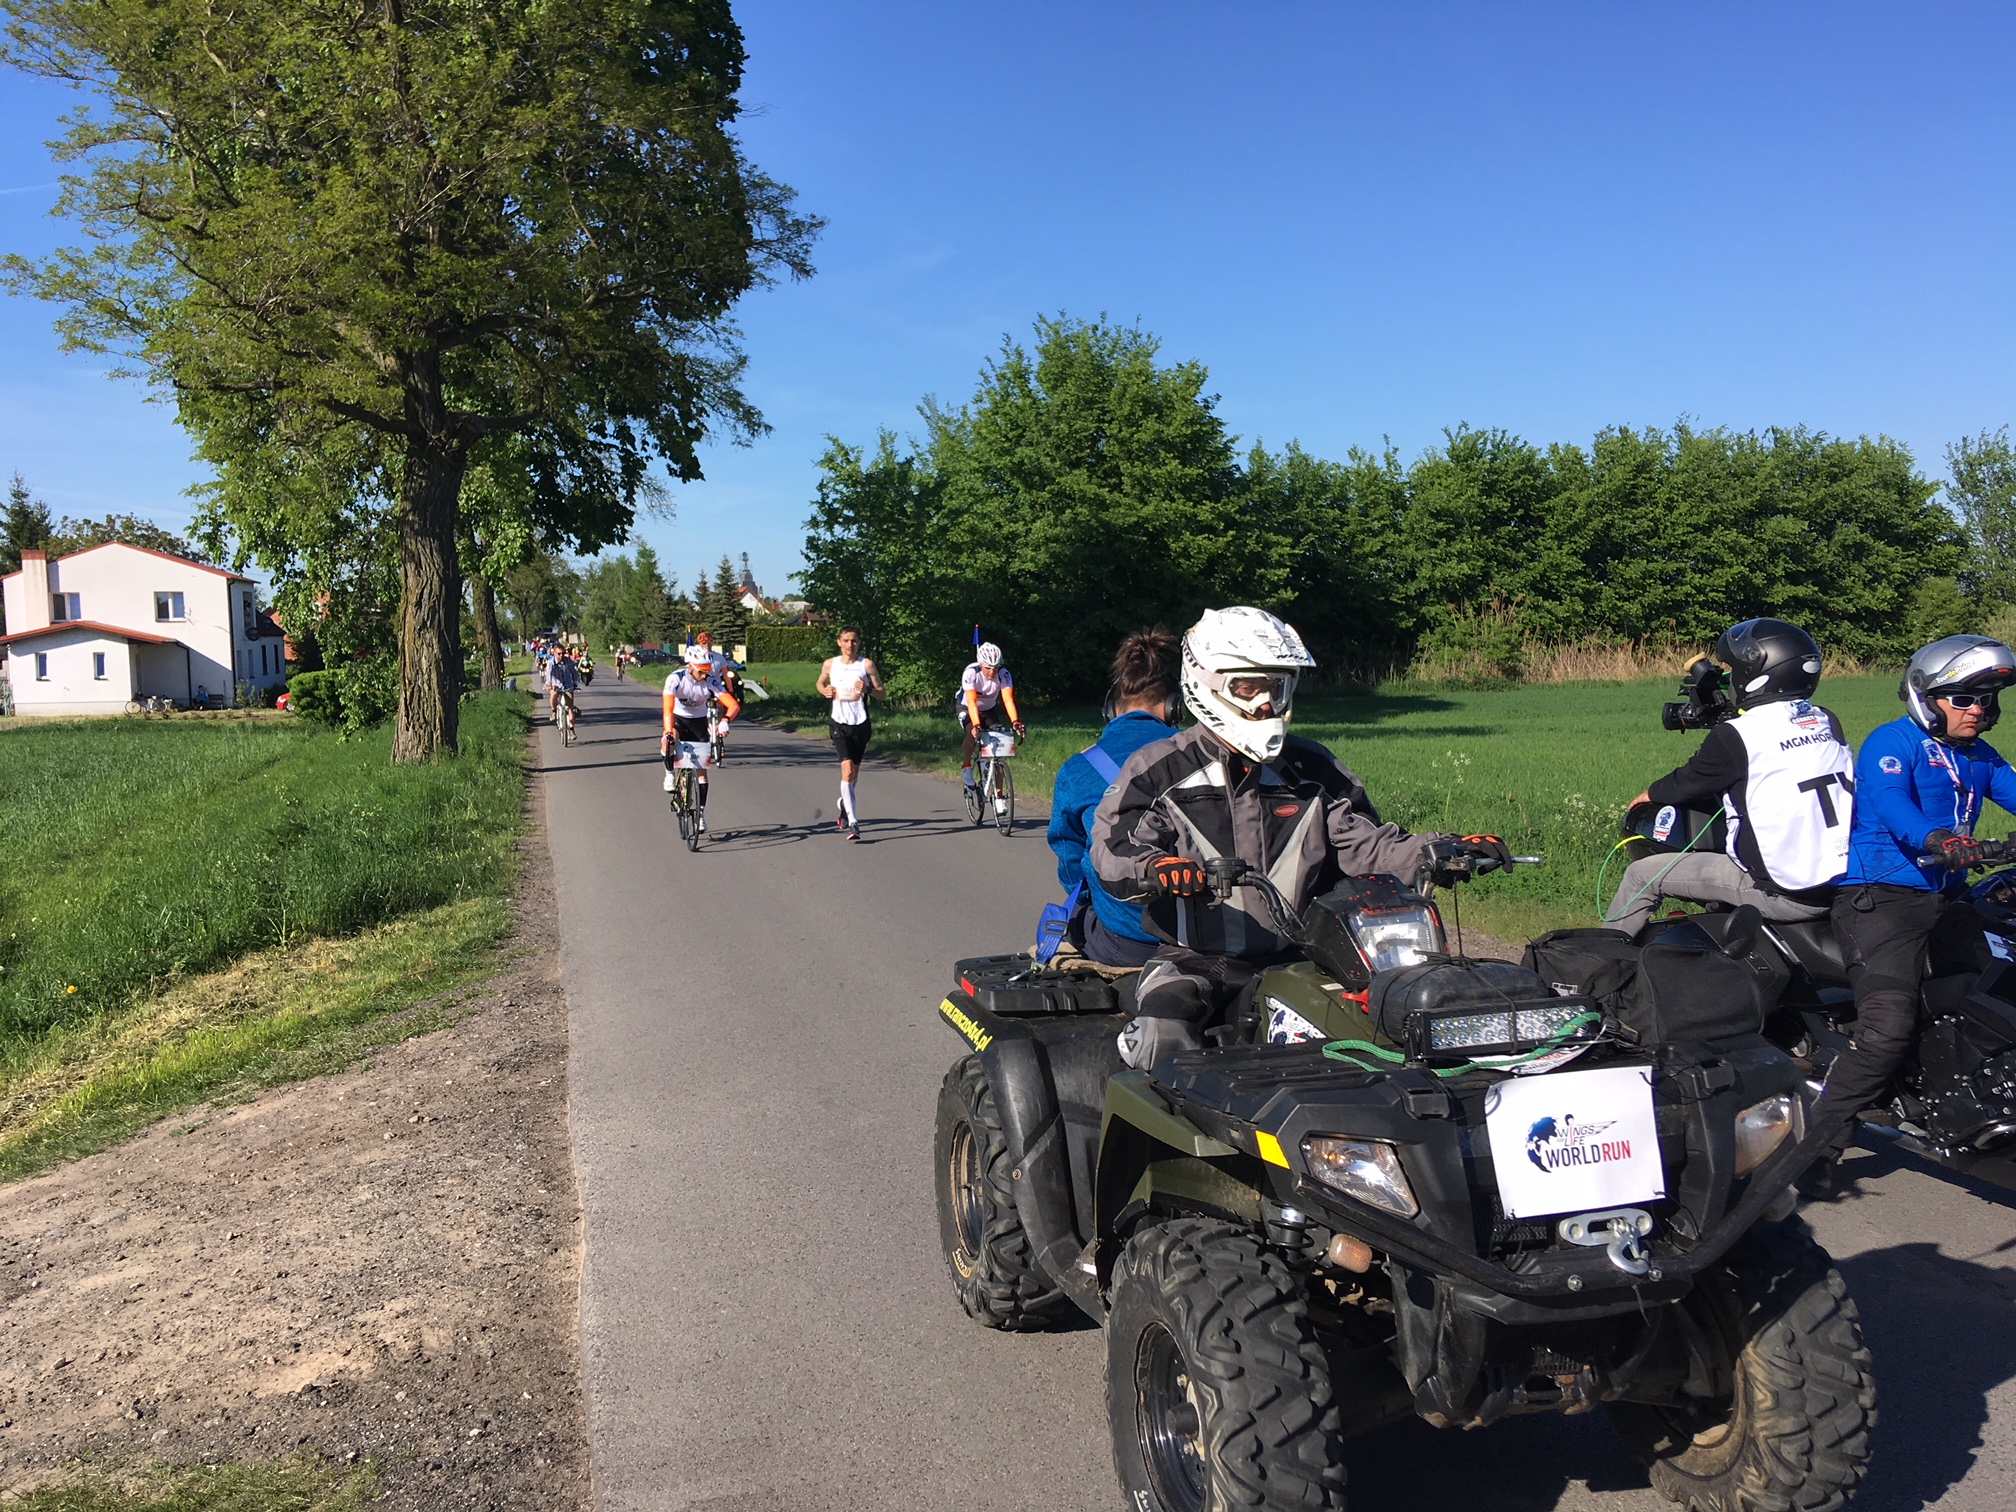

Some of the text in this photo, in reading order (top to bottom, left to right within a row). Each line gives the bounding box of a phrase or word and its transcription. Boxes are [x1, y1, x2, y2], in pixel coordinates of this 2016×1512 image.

[1779, 735, 1813, 751] MGM
[1557, 1124, 1595, 1138] WINGS
[1564, 1135, 1586, 1147] LIFE
